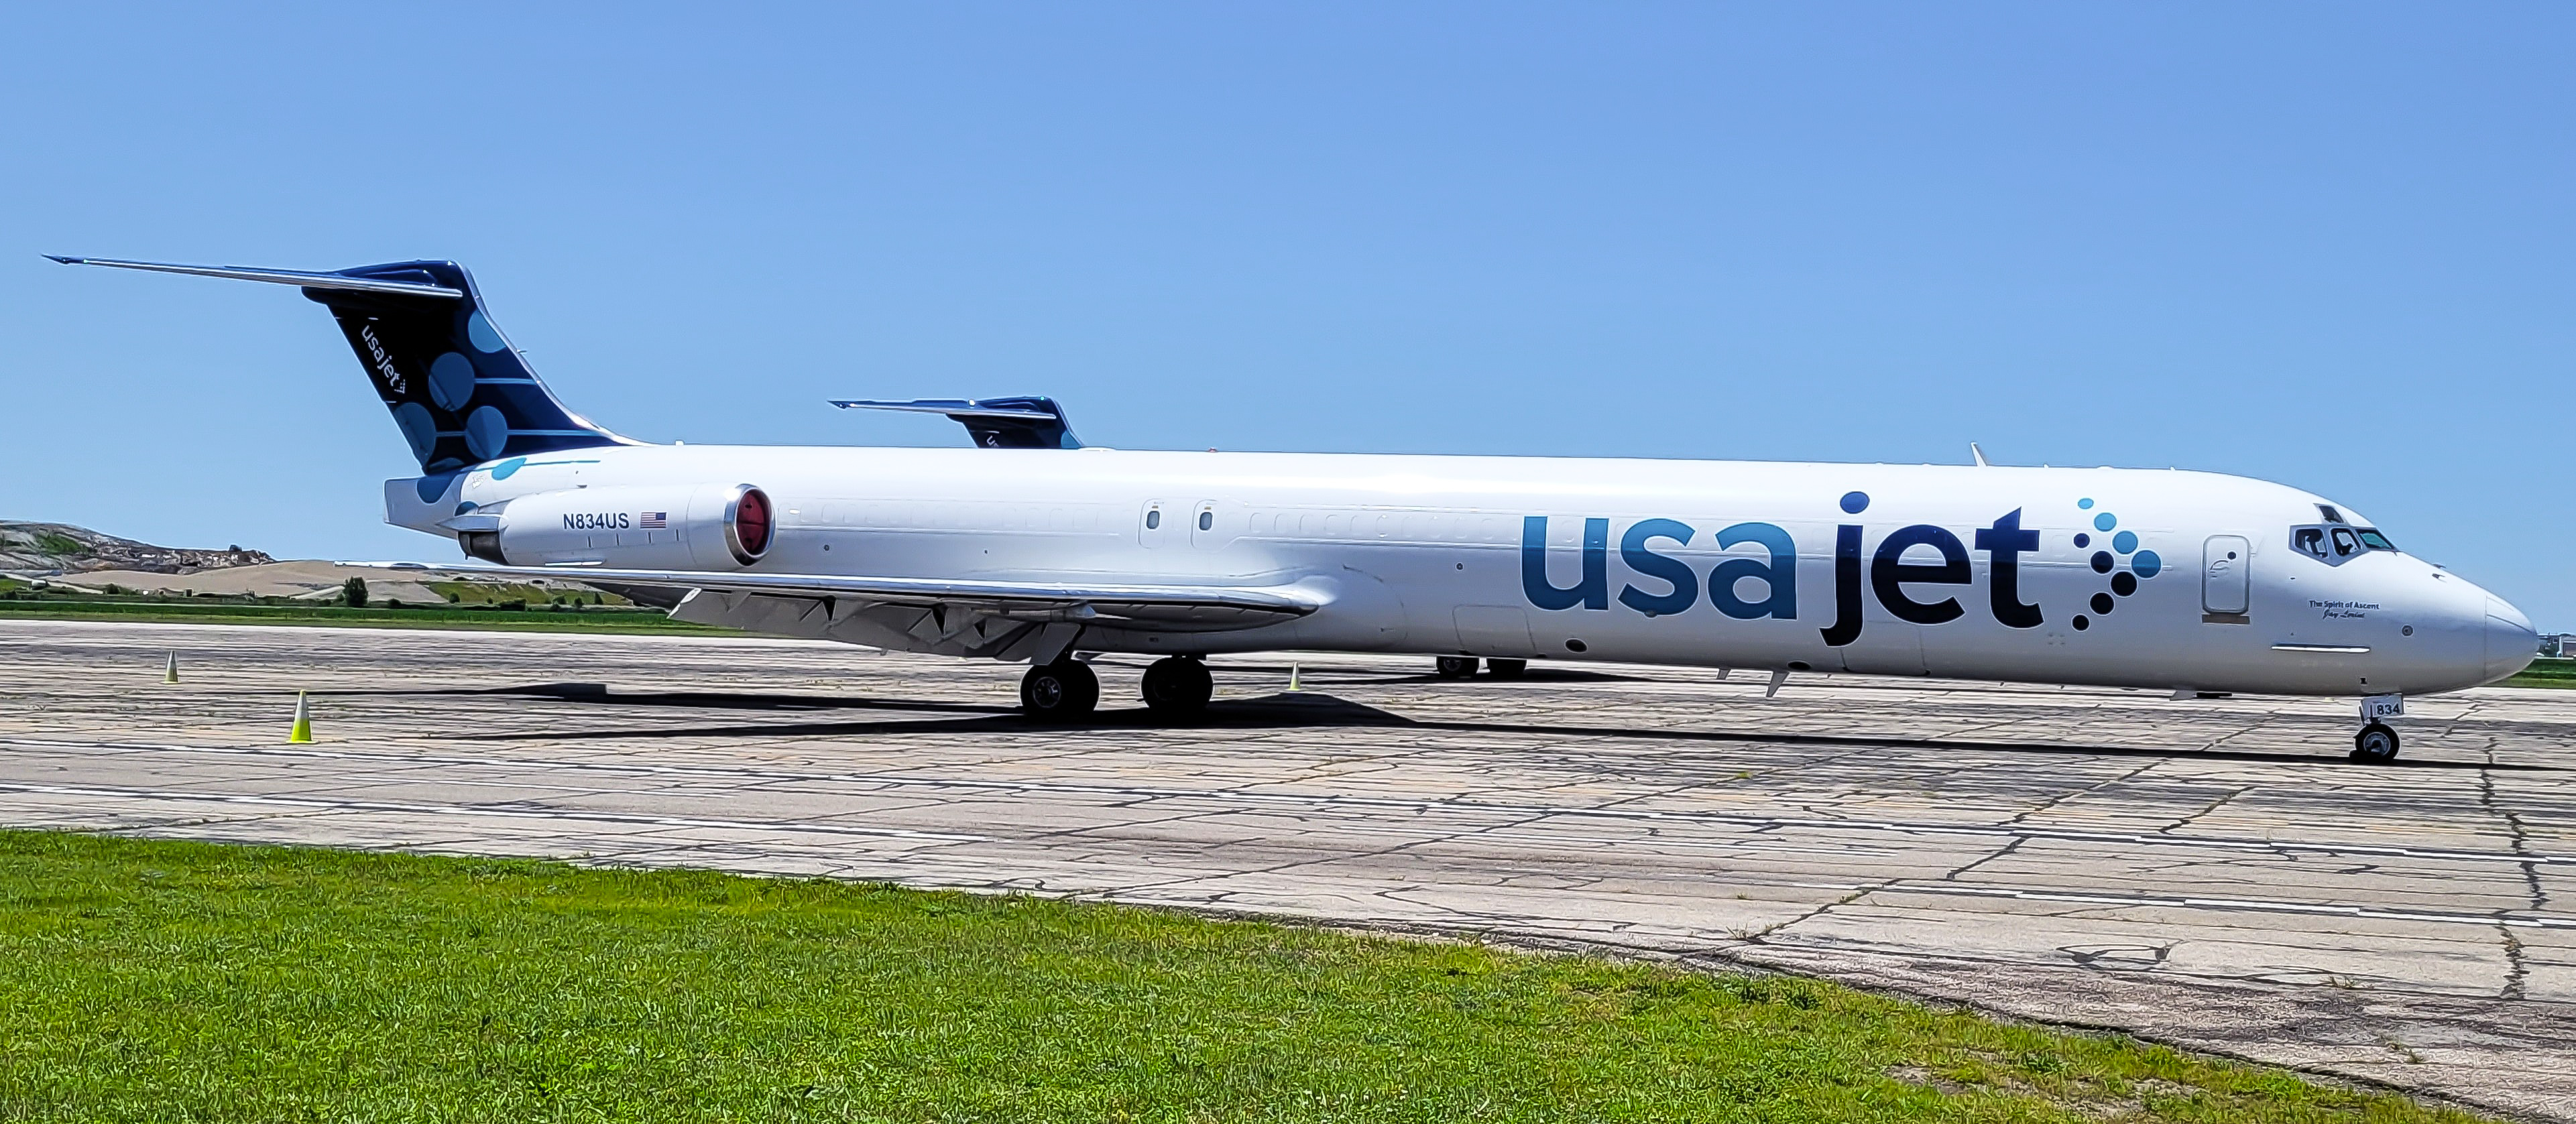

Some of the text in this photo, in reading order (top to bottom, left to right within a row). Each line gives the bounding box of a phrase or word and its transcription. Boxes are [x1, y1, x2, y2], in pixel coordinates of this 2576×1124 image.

[563, 513, 630, 529] N834US
[1521, 491, 2045, 647] usa jet
[2309, 600, 2323, 608] The
[2324, 601, 2344, 609] Spirit
[2354, 602, 2380, 610] Ascent
[2377, 702, 2400, 715] 834
